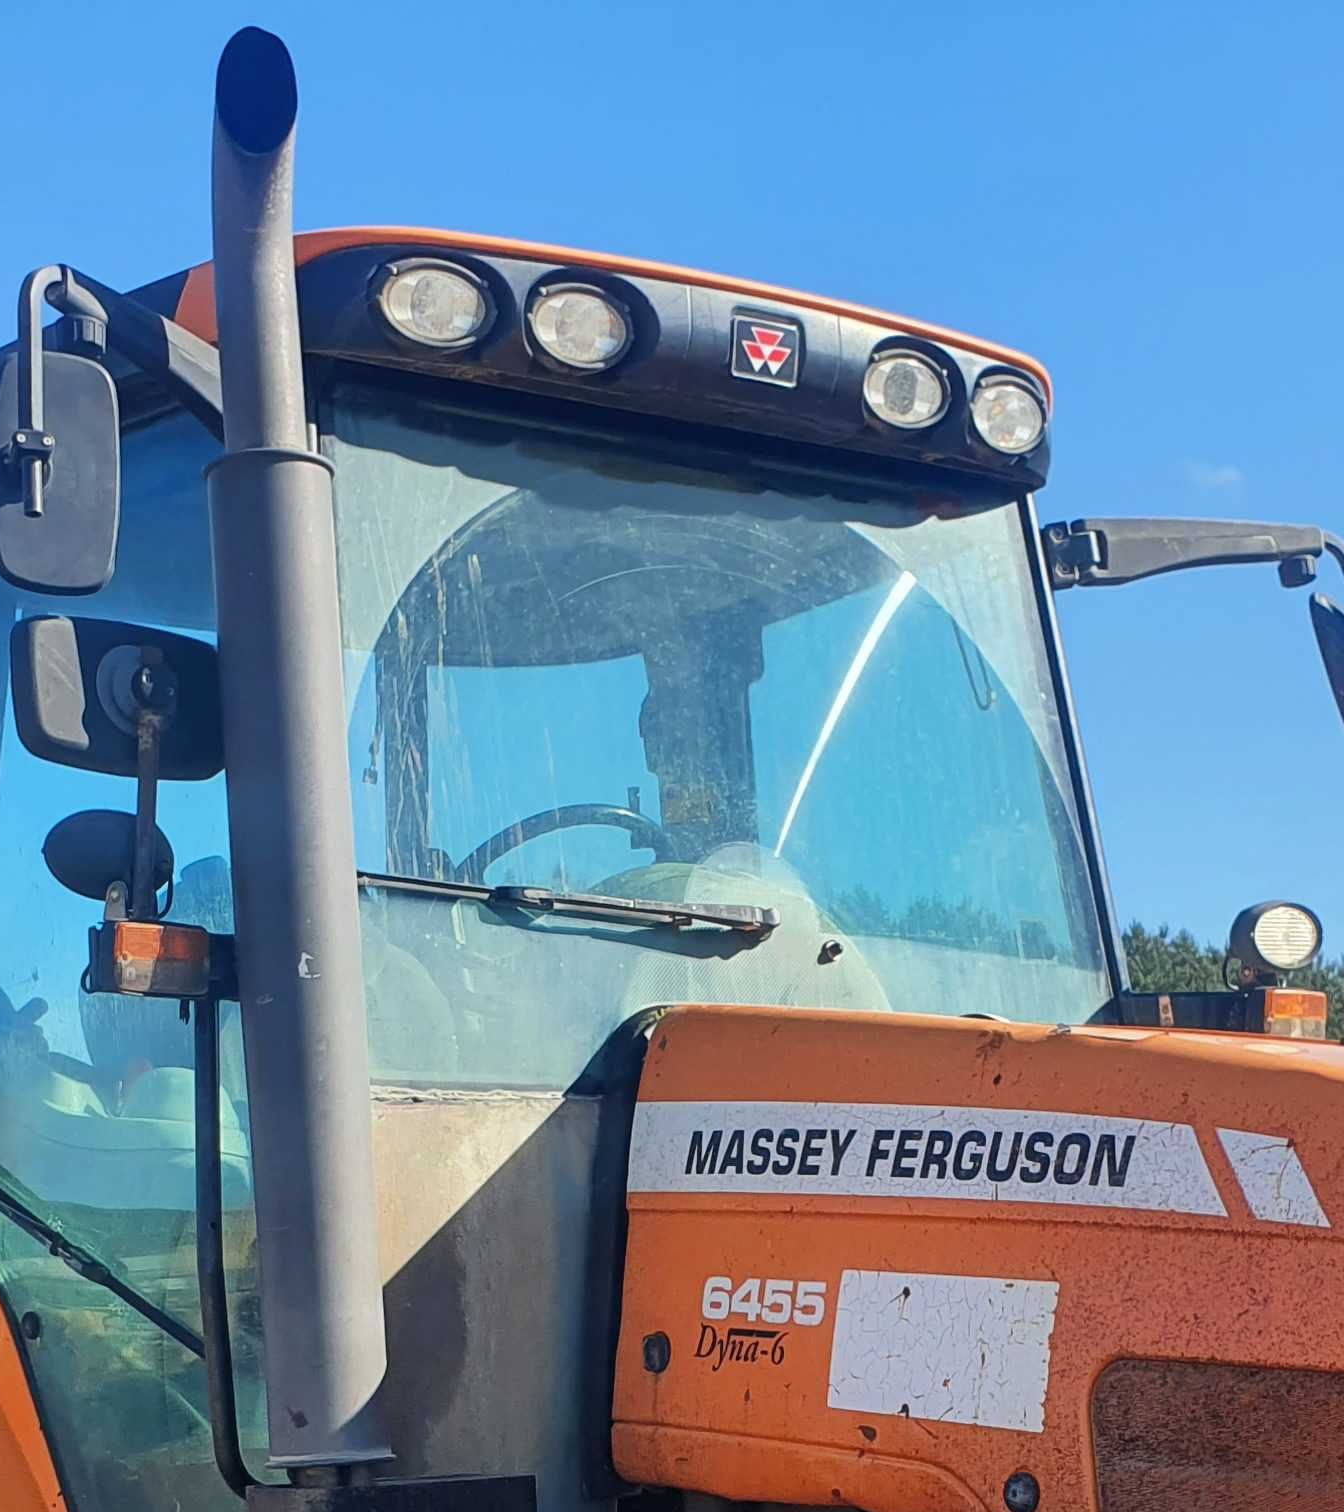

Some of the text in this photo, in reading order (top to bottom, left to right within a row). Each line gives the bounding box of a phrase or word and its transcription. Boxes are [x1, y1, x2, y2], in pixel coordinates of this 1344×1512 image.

[684, 1128, 1137, 1188] MASSEY FERGUSON
[702, 1275, 827, 1327] 6455
[694, 1321, 790, 1372] Dyna-6
